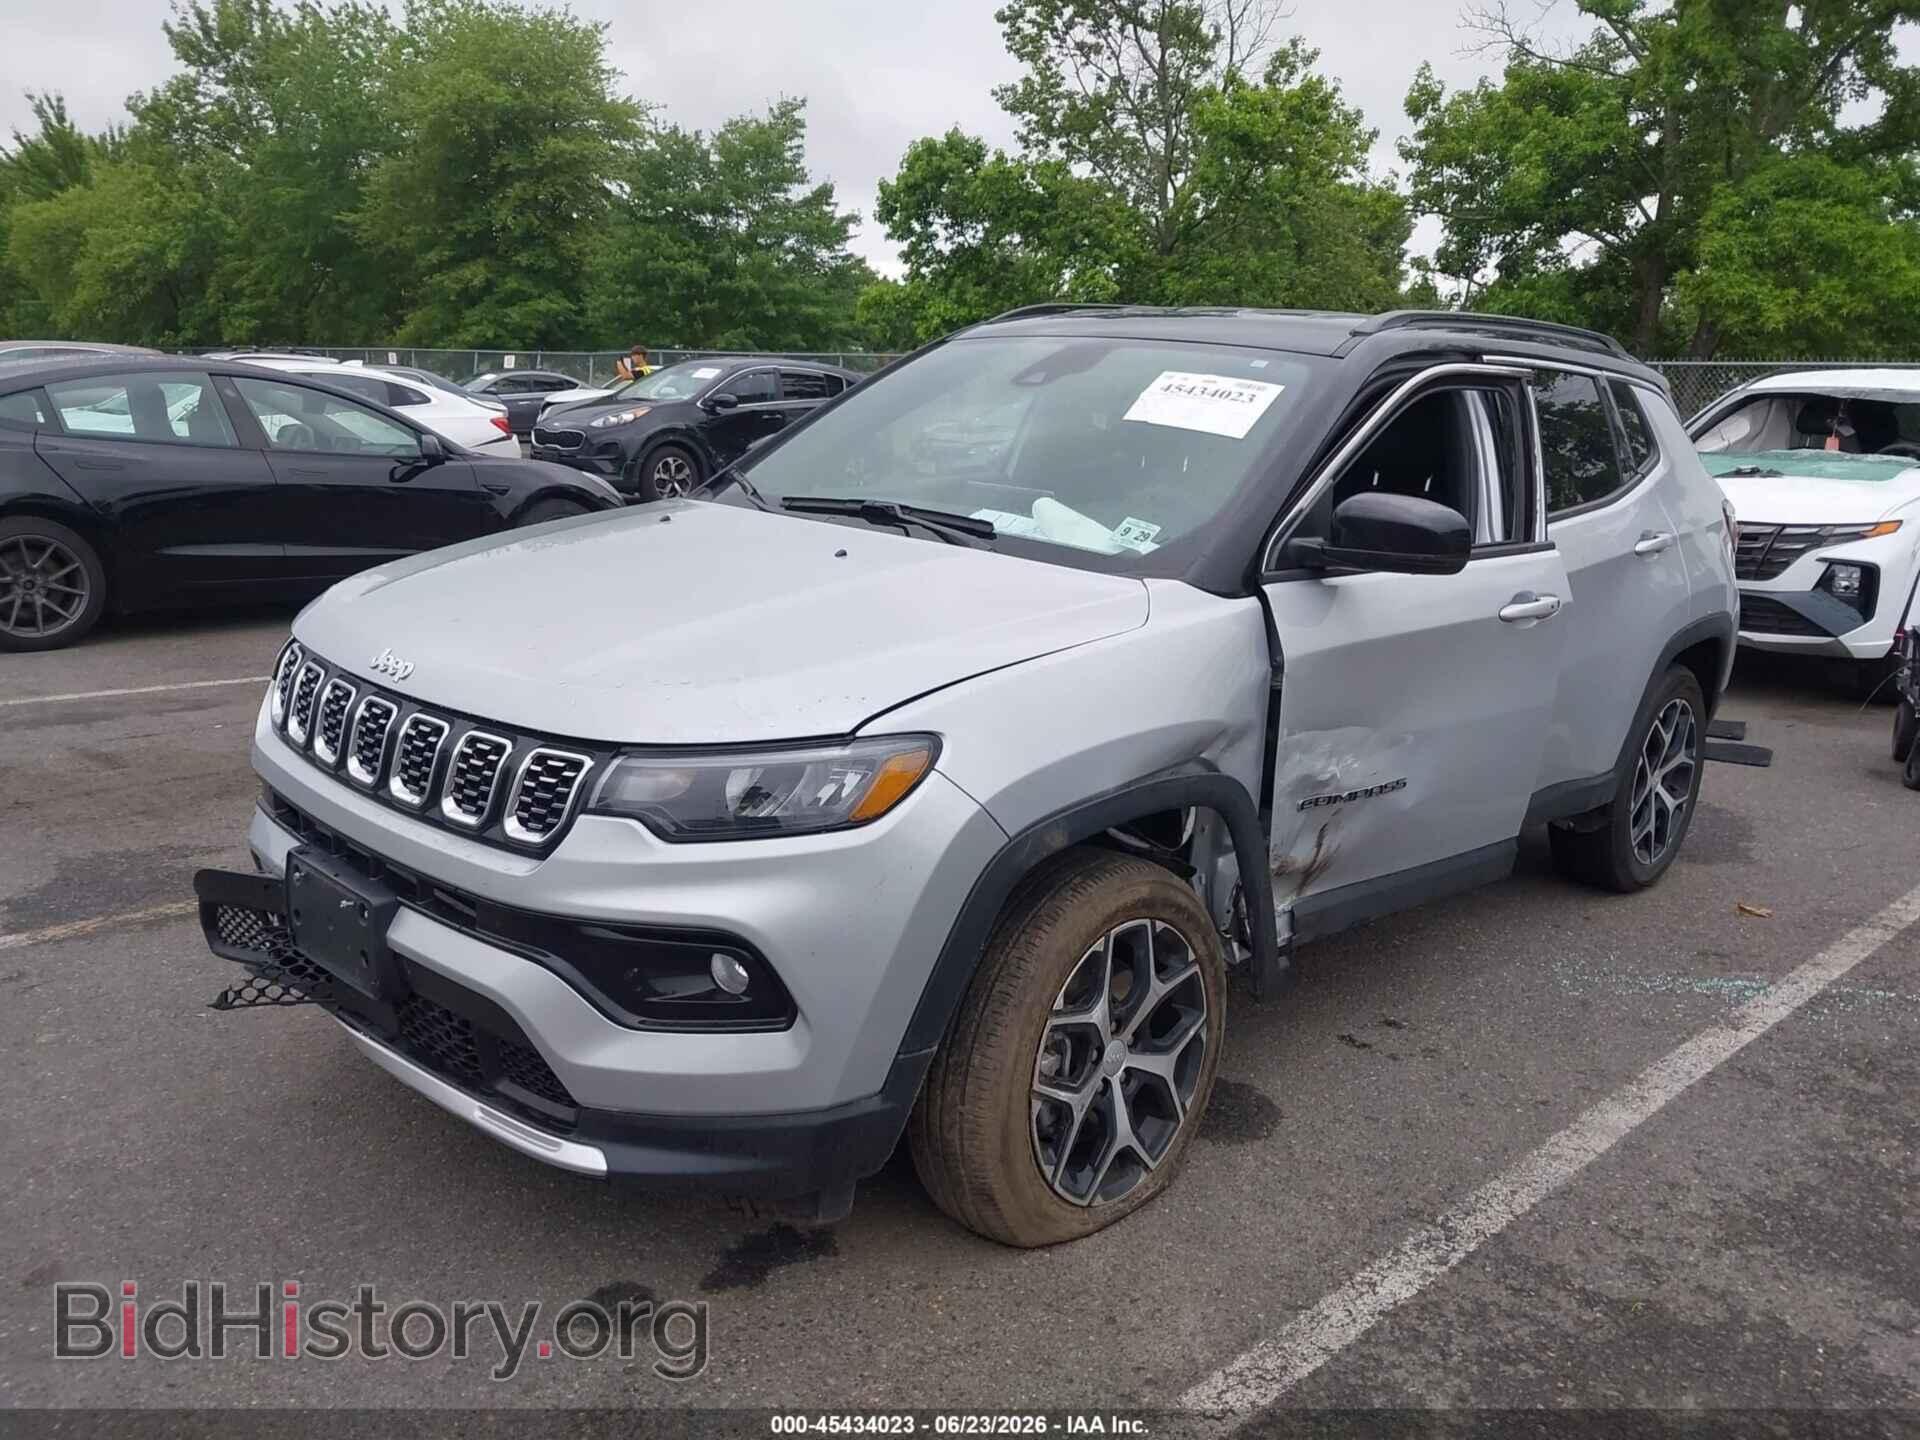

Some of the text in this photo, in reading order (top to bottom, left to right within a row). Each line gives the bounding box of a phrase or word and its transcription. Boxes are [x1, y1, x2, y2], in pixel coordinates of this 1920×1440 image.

[1161, 384, 1256, 402] 45434023
[1133, 530, 1151, 542] 29
[370, 648, 414, 683] Jeep
[1297, 777, 1407, 811] COMPASS
